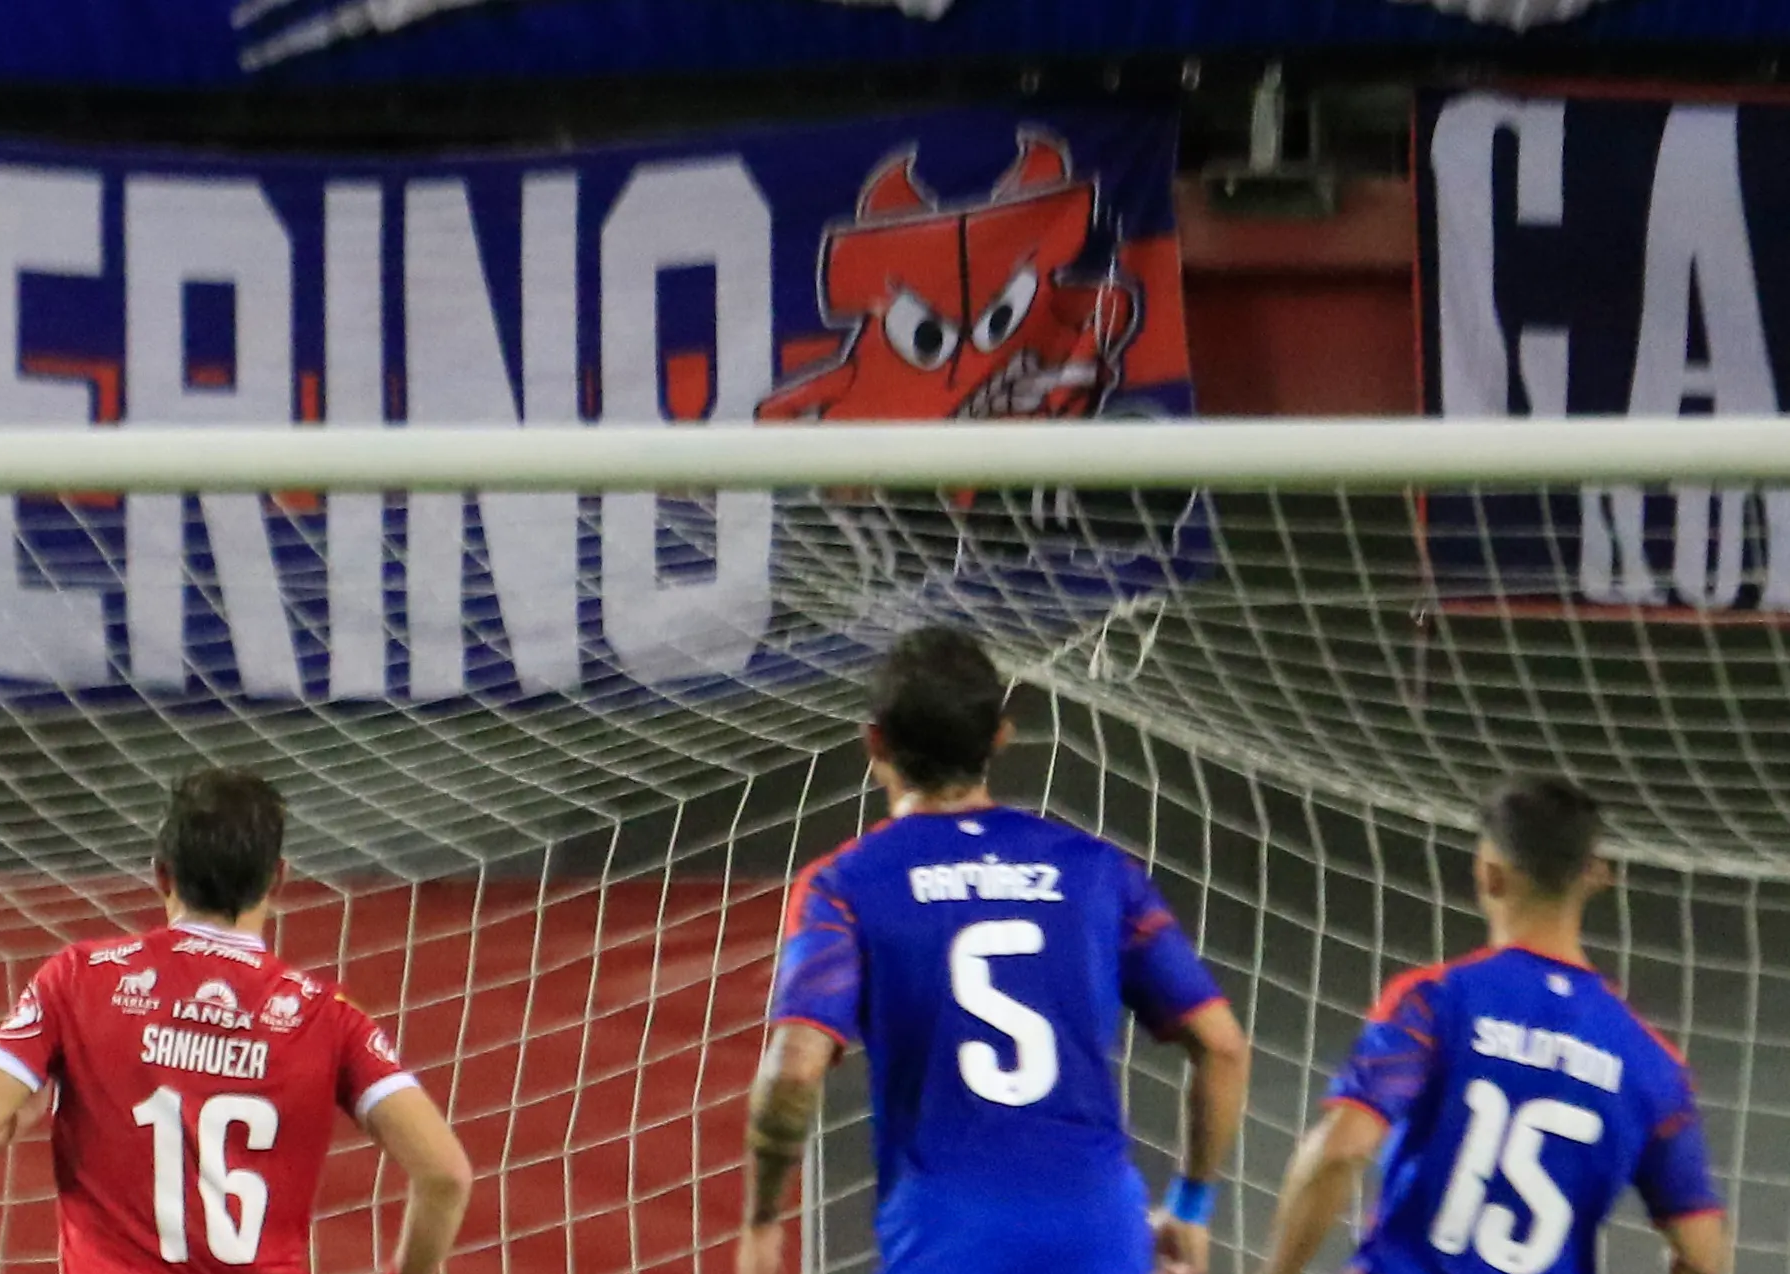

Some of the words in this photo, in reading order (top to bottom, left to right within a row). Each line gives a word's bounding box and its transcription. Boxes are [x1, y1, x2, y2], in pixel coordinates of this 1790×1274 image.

[140, 1022, 269, 1080] SANHUEZA
[172, 1000, 253, 1031] IANSA
[948, 918, 1060, 1108] 5
[132, 1084, 280, 1266] 16
